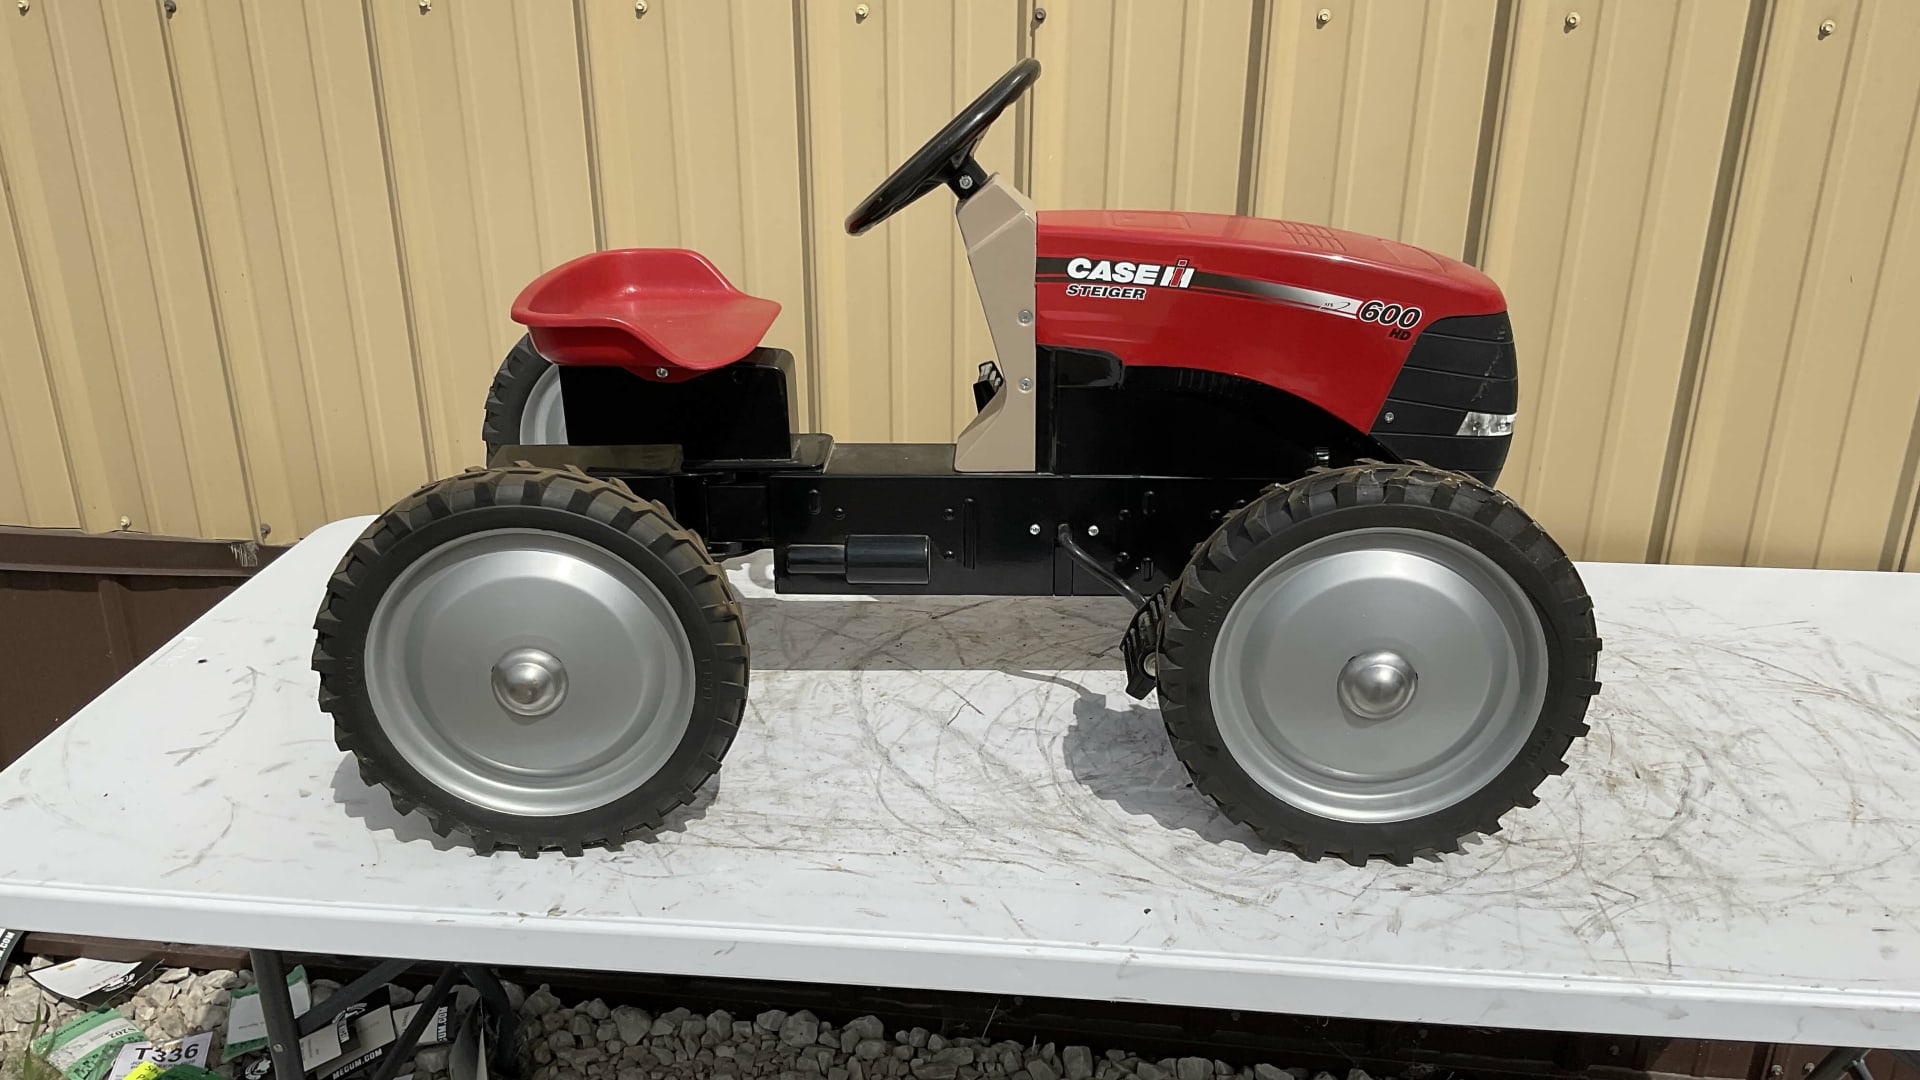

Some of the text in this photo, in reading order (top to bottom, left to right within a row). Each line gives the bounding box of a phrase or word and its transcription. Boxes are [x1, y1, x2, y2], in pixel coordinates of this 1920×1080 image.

[1067, 257, 1161, 286] CASE
[1066, 284, 1146, 300] STEIGER
[1359, 300, 1422, 330] 600
[1388, 329, 1412, 341] HD
[136, 1043, 199, 1063] T336
[332, 1048, 383, 1080] MECUM.COM
